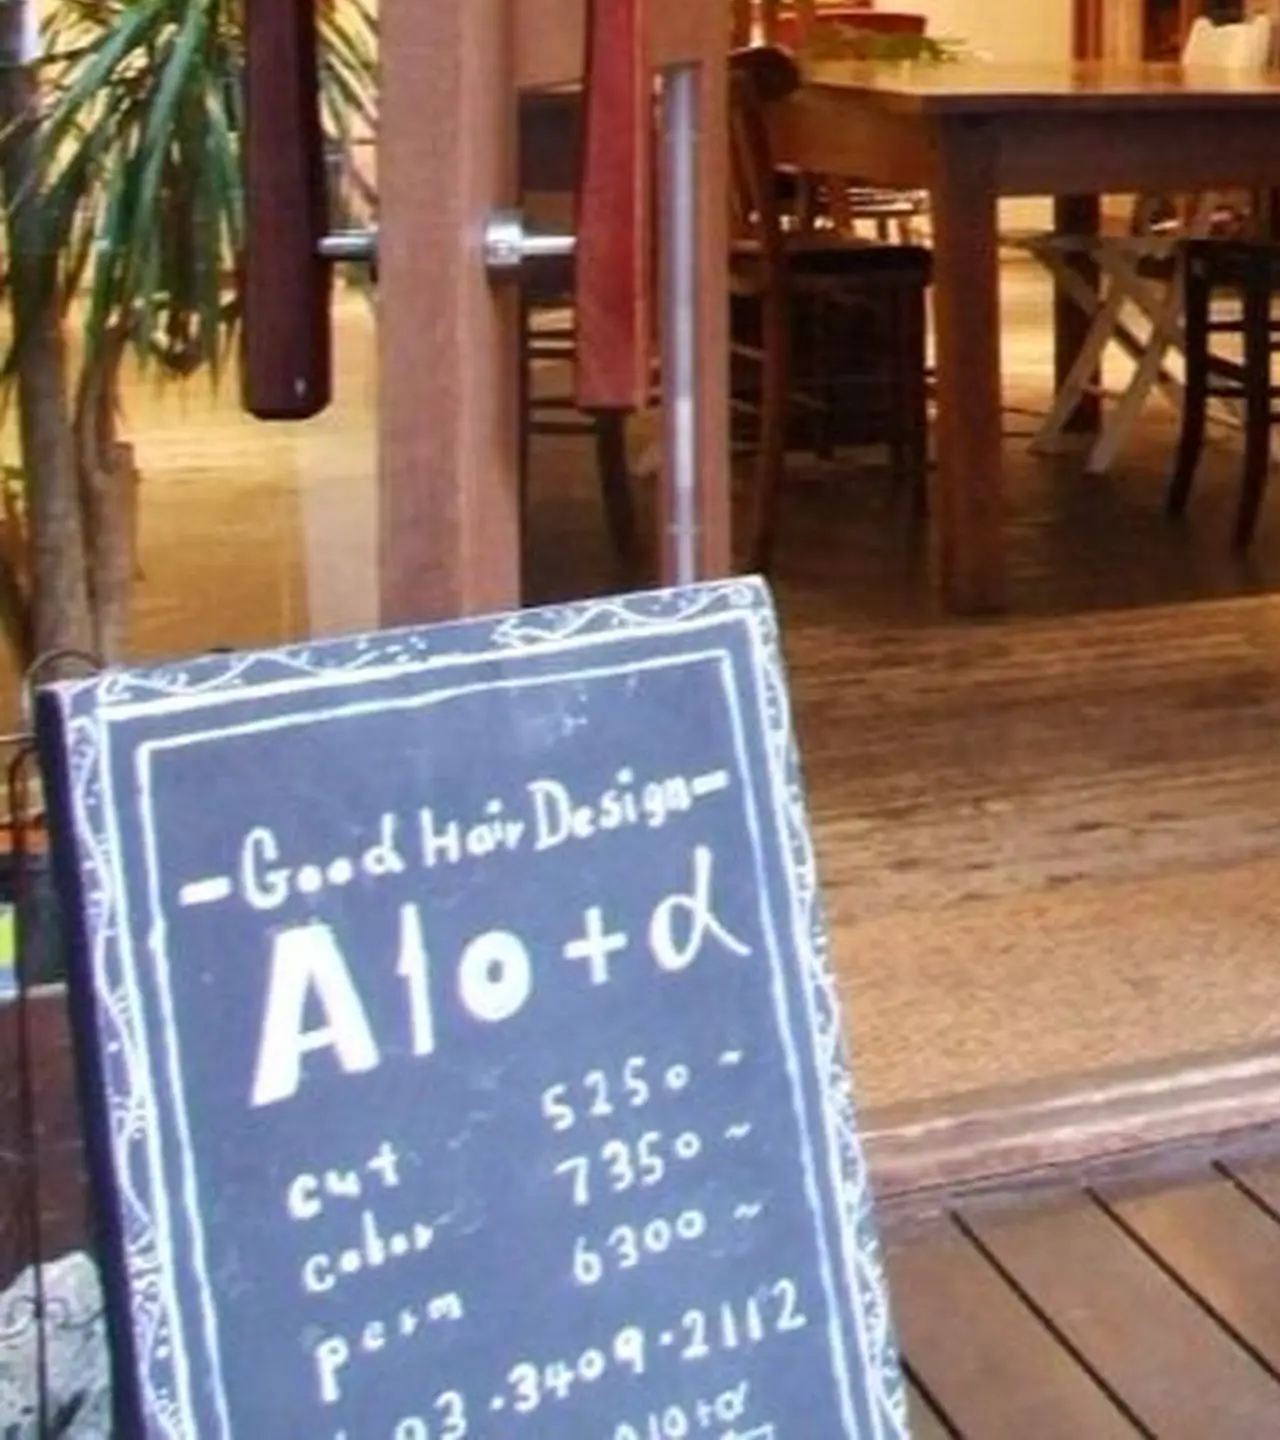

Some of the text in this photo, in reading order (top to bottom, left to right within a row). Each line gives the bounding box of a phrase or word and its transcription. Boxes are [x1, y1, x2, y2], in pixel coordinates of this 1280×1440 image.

[418, 798, 526, 868] Hair
[286, 1141, 400, 1221] cut
[301, 1209, 435, 1294] color
[313, 1291, 464, 1404] perm
